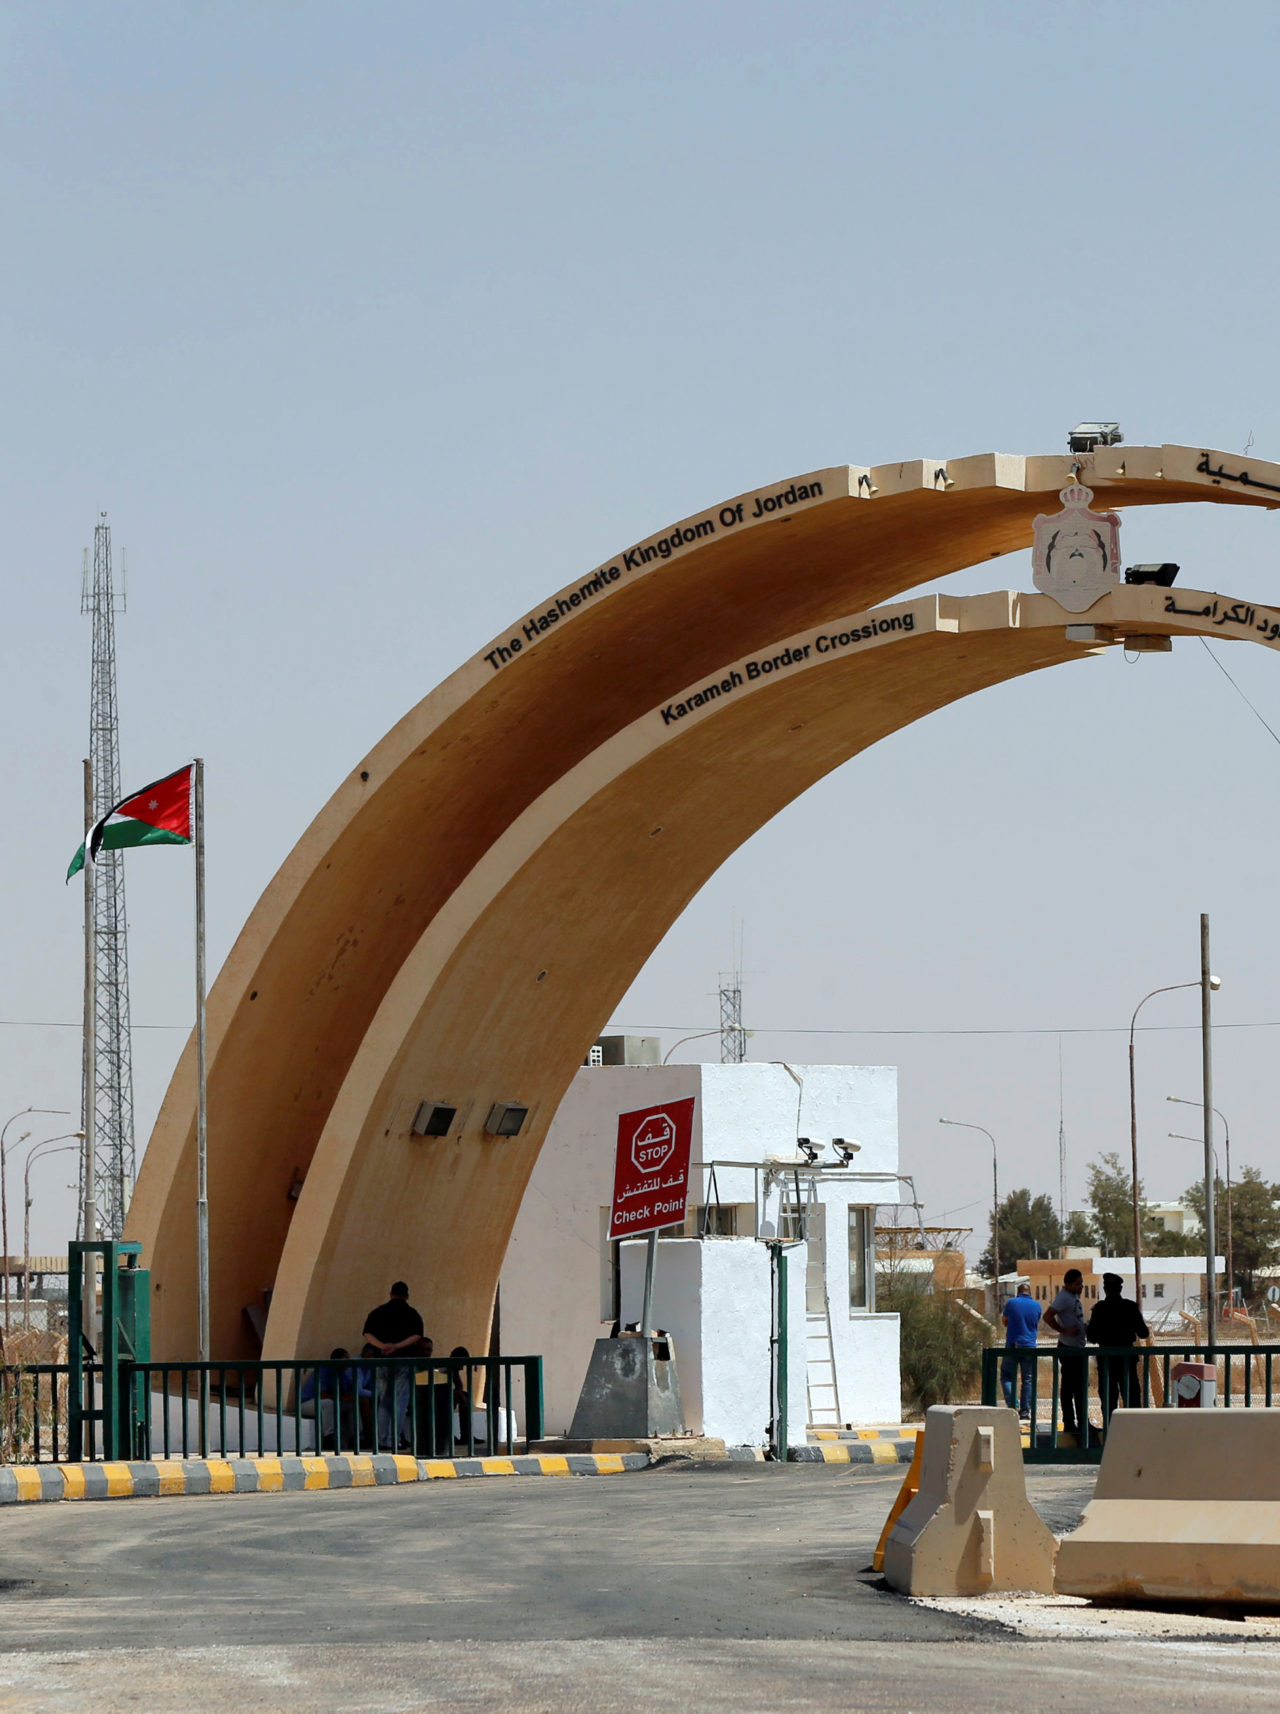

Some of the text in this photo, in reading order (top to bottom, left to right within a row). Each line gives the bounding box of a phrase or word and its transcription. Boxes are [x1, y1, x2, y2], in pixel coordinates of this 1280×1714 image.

[484, 480, 824, 671] The Hashemite Kingdom Of Jordan
[1164, 596, 1256, 627] الكرامة
[661, 611, 915, 724] Karameh Border Crossiong
[638, 1123, 670, 1145] قف
[639, 1145, 668, 1161] STOP
[662, 1169, 684, 1188] قف
[614, 1197, 684, 1225] Check Point
